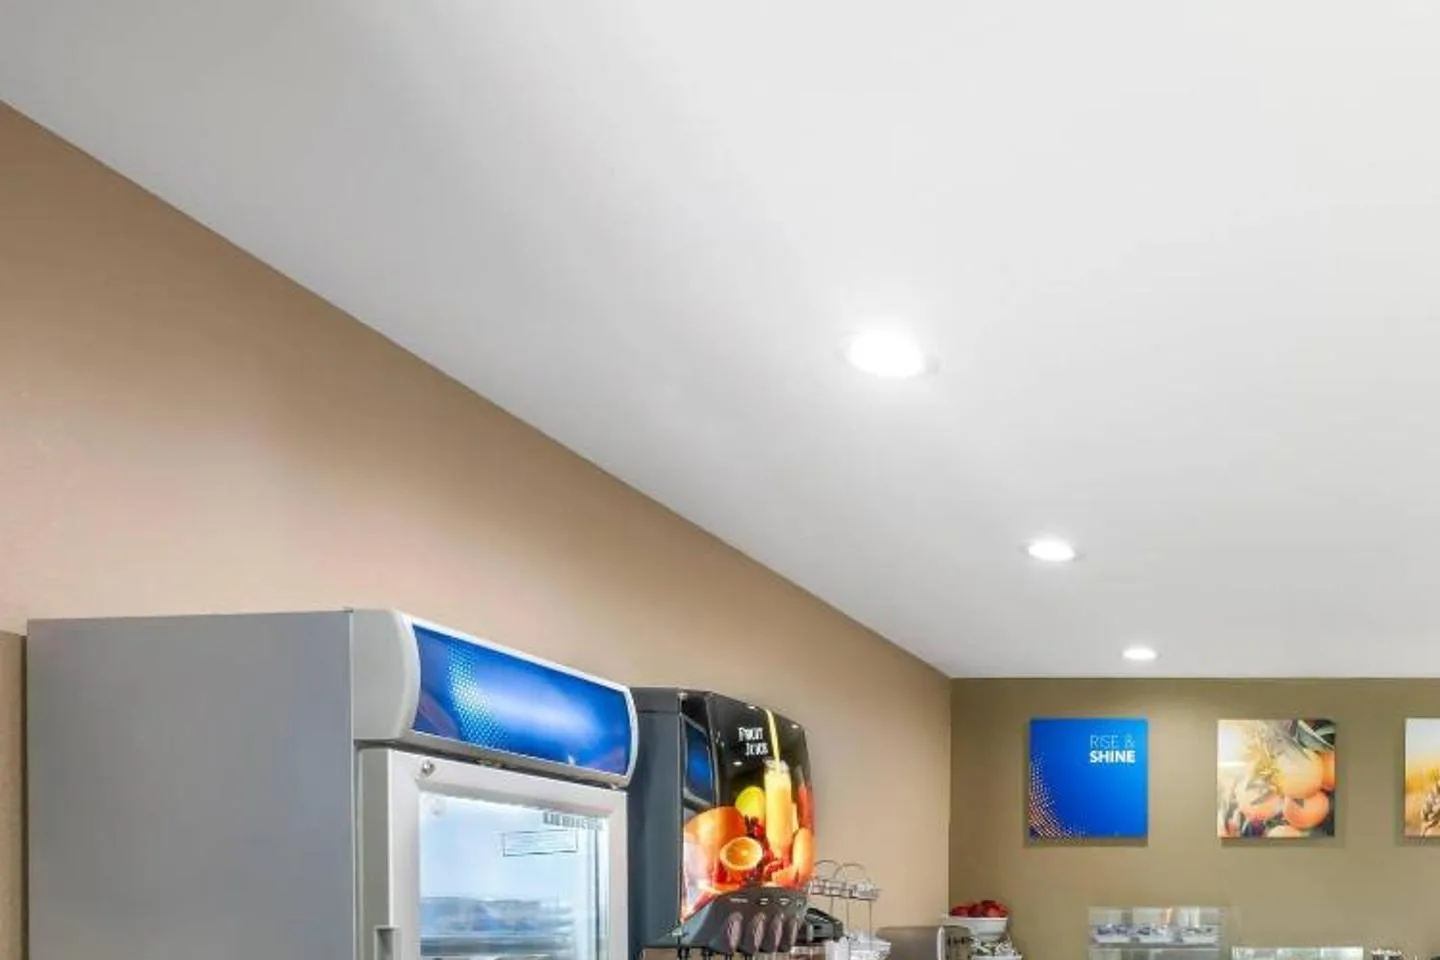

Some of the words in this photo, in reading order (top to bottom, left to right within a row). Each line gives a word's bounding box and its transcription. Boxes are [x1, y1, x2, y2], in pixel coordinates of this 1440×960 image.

[1090, 734, 1119, 749] RISE
[1124, 734, 1136, 749] &
[1090, 749, 1136, 764] SHINE
